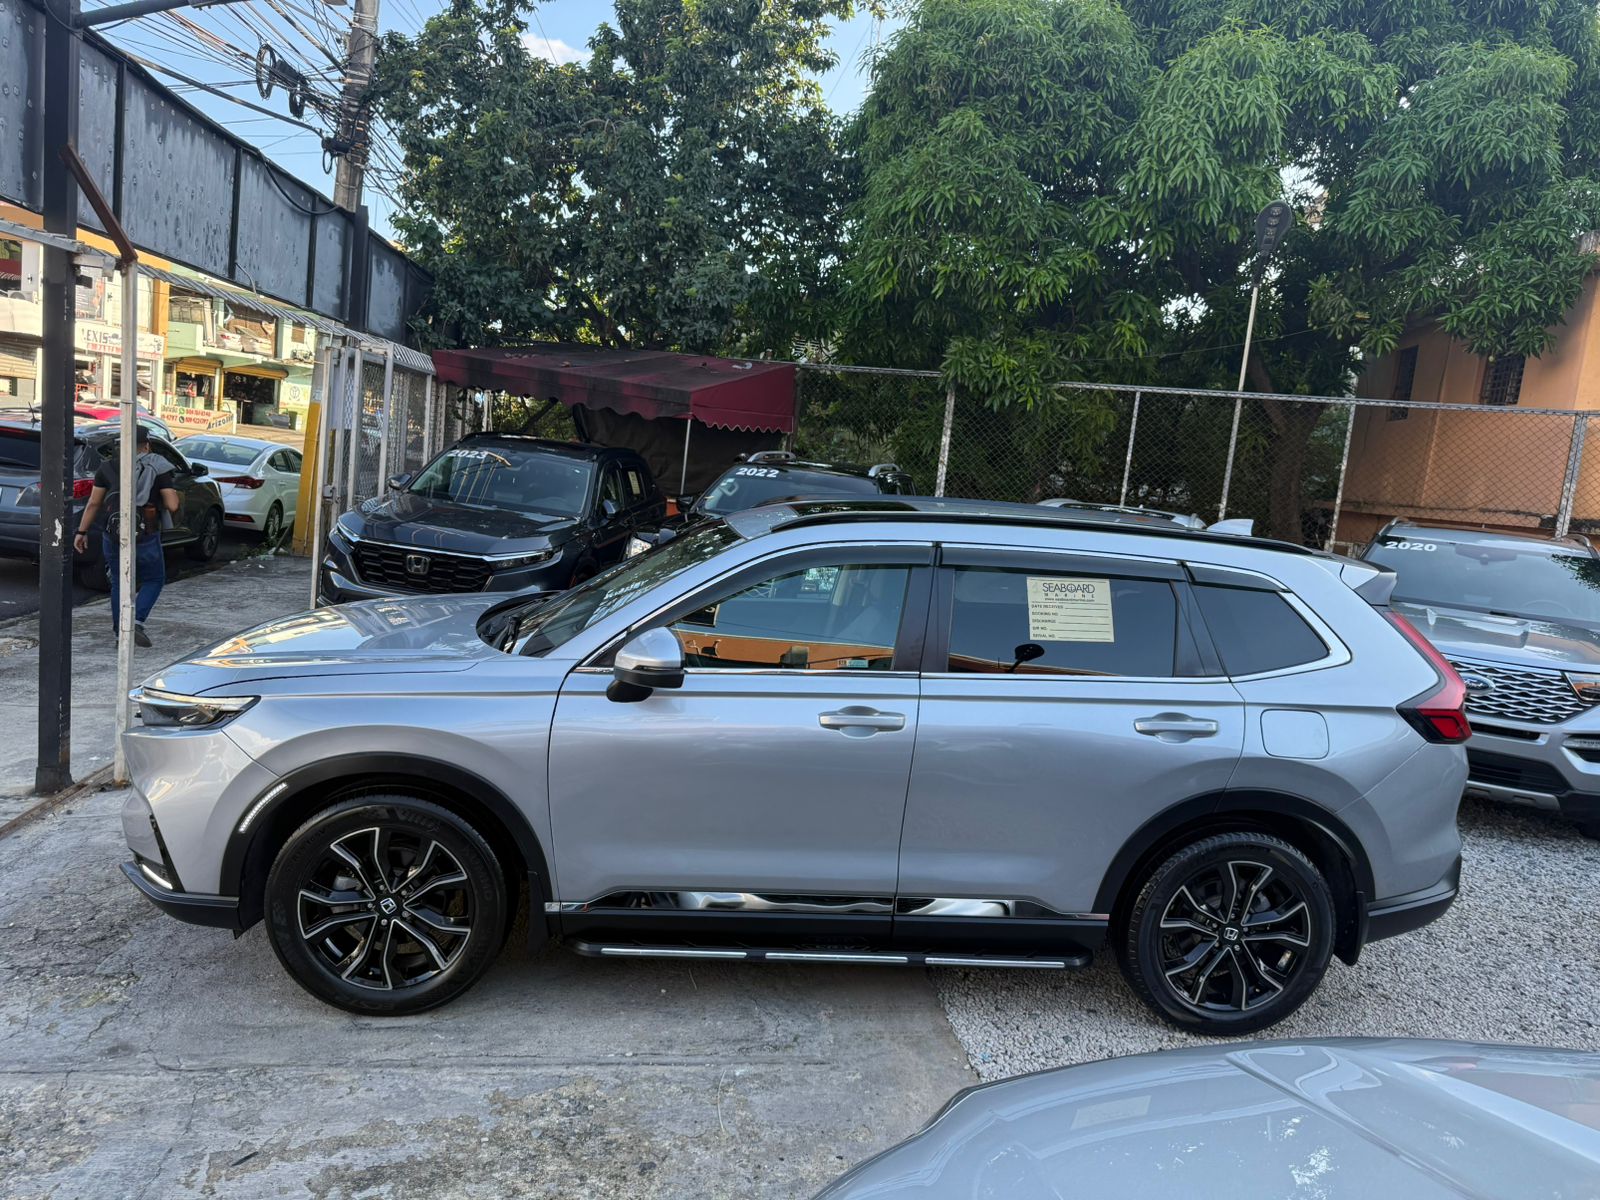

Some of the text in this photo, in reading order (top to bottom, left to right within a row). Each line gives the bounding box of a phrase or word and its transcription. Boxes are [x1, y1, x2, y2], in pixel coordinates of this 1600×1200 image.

[449, 449, 487, 459] 2023
[736, 467, 780, 478] 2022
[1384, 541, 1437, 552] 2020
[1042, 582, 1095, 594] SEABOARD
